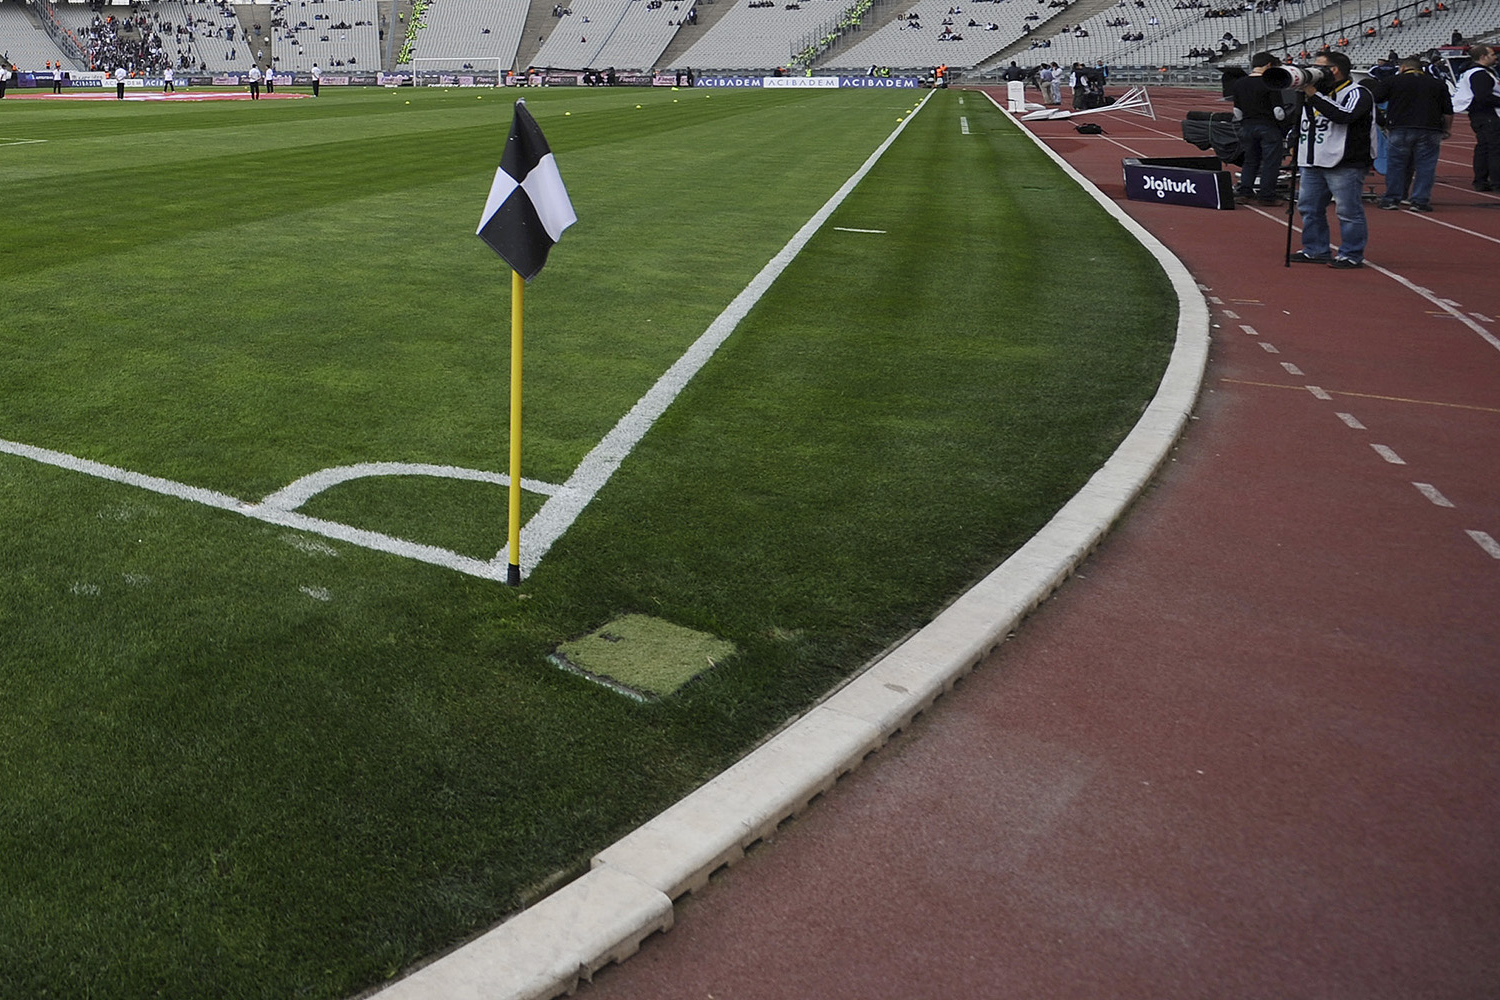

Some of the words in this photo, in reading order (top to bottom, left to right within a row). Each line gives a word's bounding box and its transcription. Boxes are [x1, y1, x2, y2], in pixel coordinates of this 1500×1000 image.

[696, 78, 761, 87] ACIBADEM
[768, 79, 836, 87] ACIBADEM
[842, 78, 915, 88] ACIBADEM
[1142, 174, 1197, 198] Digiturk
